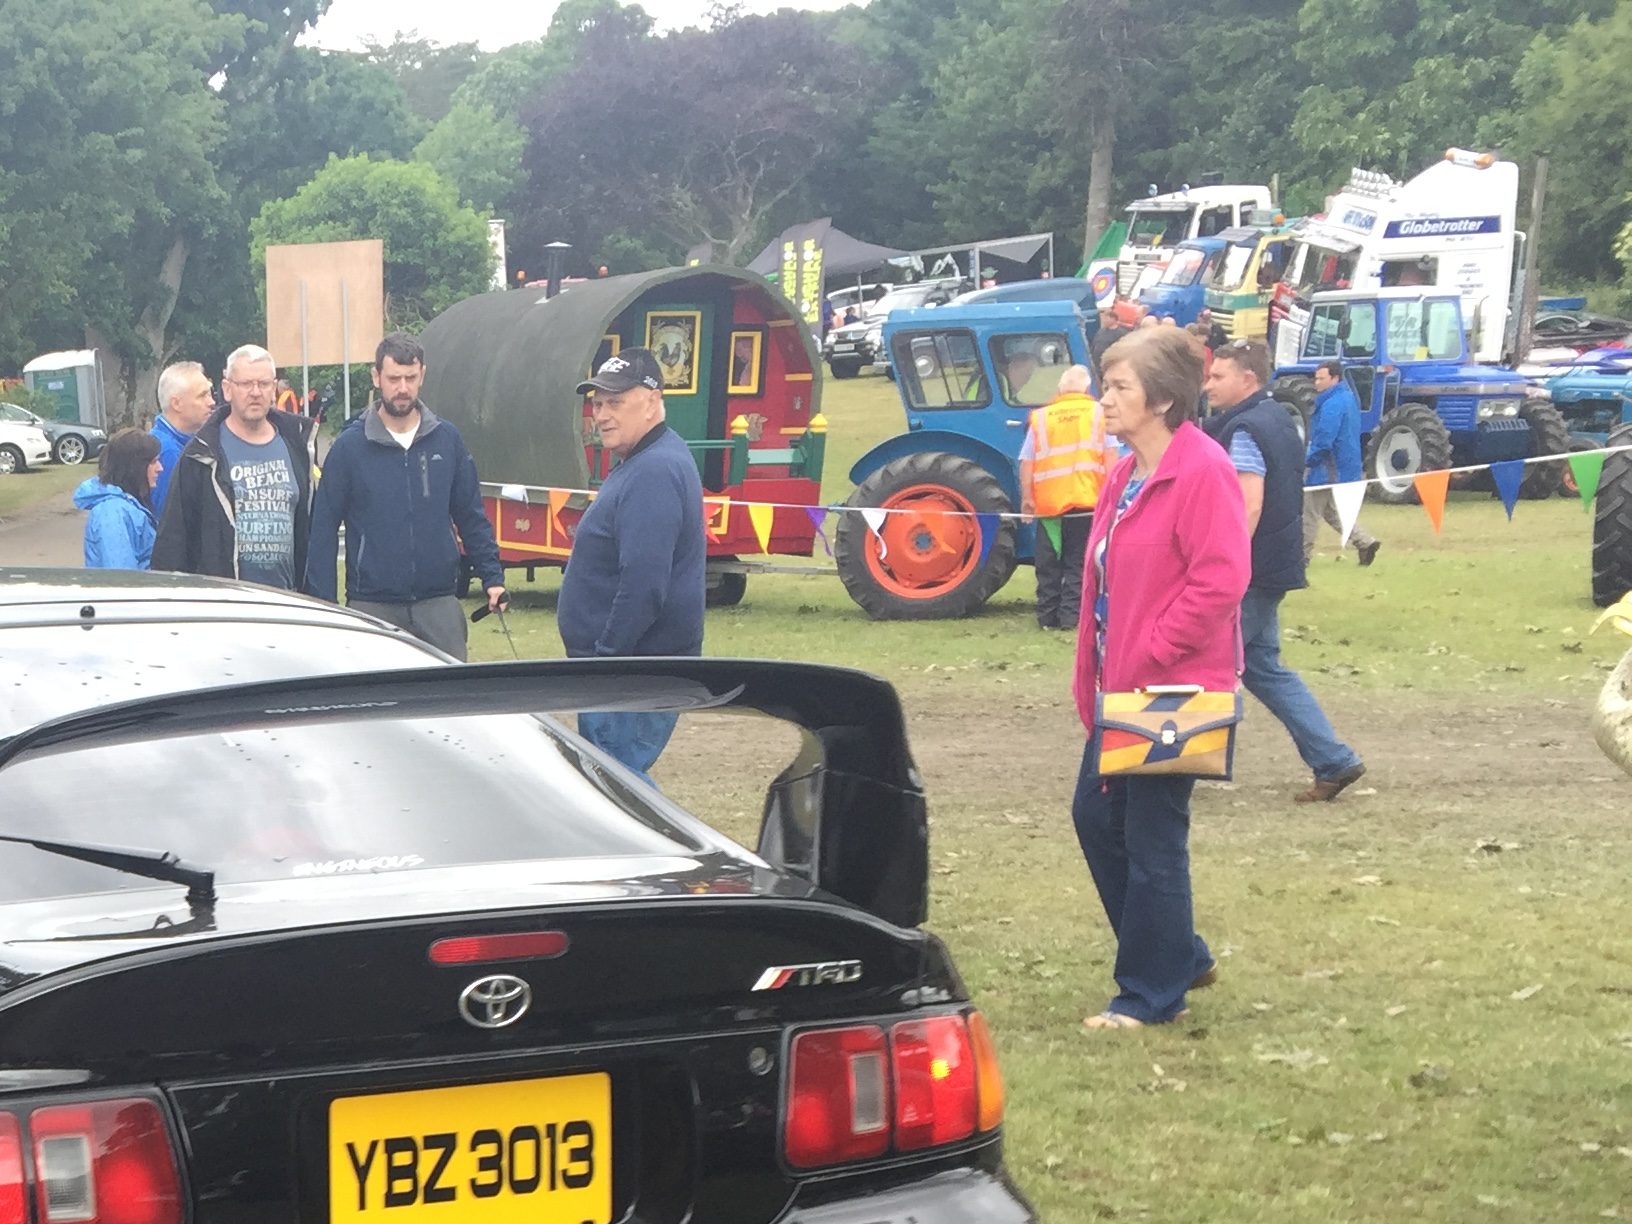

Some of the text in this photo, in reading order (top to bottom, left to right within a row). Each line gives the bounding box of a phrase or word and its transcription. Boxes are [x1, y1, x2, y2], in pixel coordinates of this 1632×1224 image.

[1399, 220, 1484, 235] Globetrotter
[230, 460, 287, 481] ORIGINAL
[245, 471, 290, 489] BEACH
[346, 1119, 594, 1212] YBZ 3013
